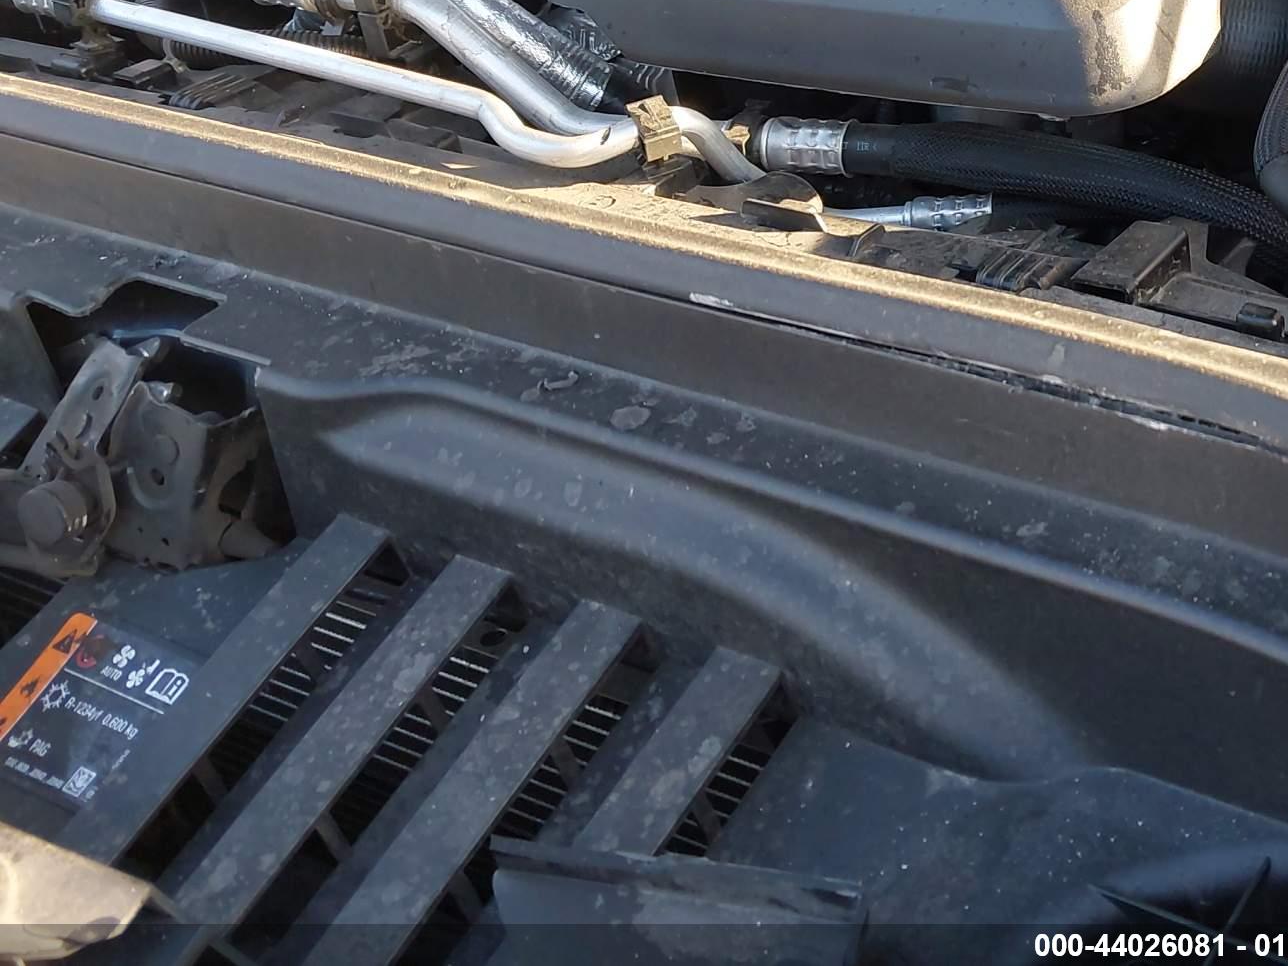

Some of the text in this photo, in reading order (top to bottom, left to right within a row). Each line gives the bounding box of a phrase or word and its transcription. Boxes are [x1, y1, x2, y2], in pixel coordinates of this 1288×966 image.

[100, 665, 123, 682] AUTO
[125, 725, 139, 740] kg
[28, 738, 51, 757] PAG
